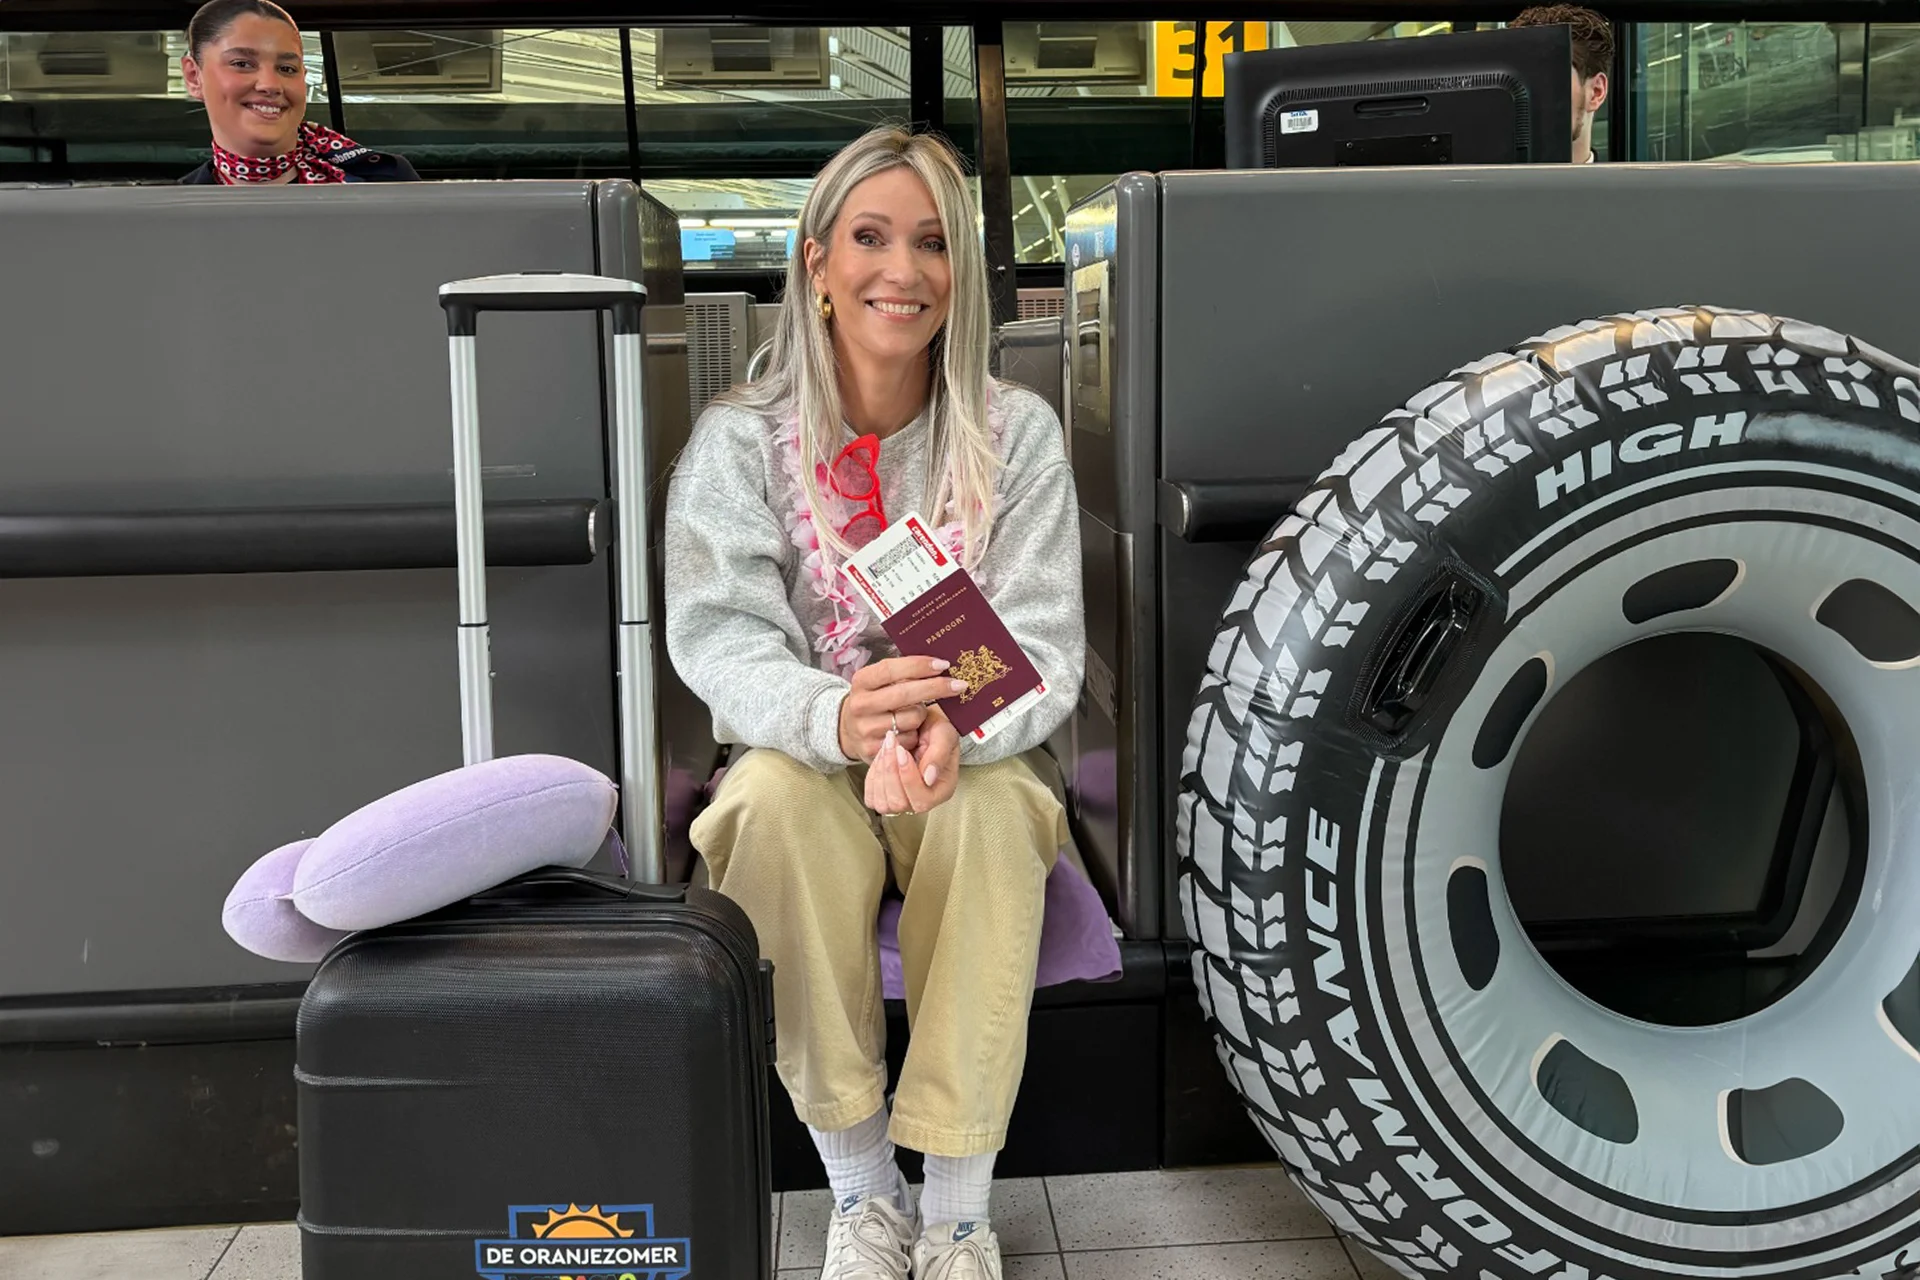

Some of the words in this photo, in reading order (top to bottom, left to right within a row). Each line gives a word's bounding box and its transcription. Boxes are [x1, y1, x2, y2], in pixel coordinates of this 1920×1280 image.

[1173, 21, 1245, 79] 31
[1535, 411, 1747, 509] HIGH
[1304, 807, 1617, 1280] FORMANCE
[486, 1248, 514, 1265] DE
[519, 1247, 678, 1265] ORANJEZOMER
